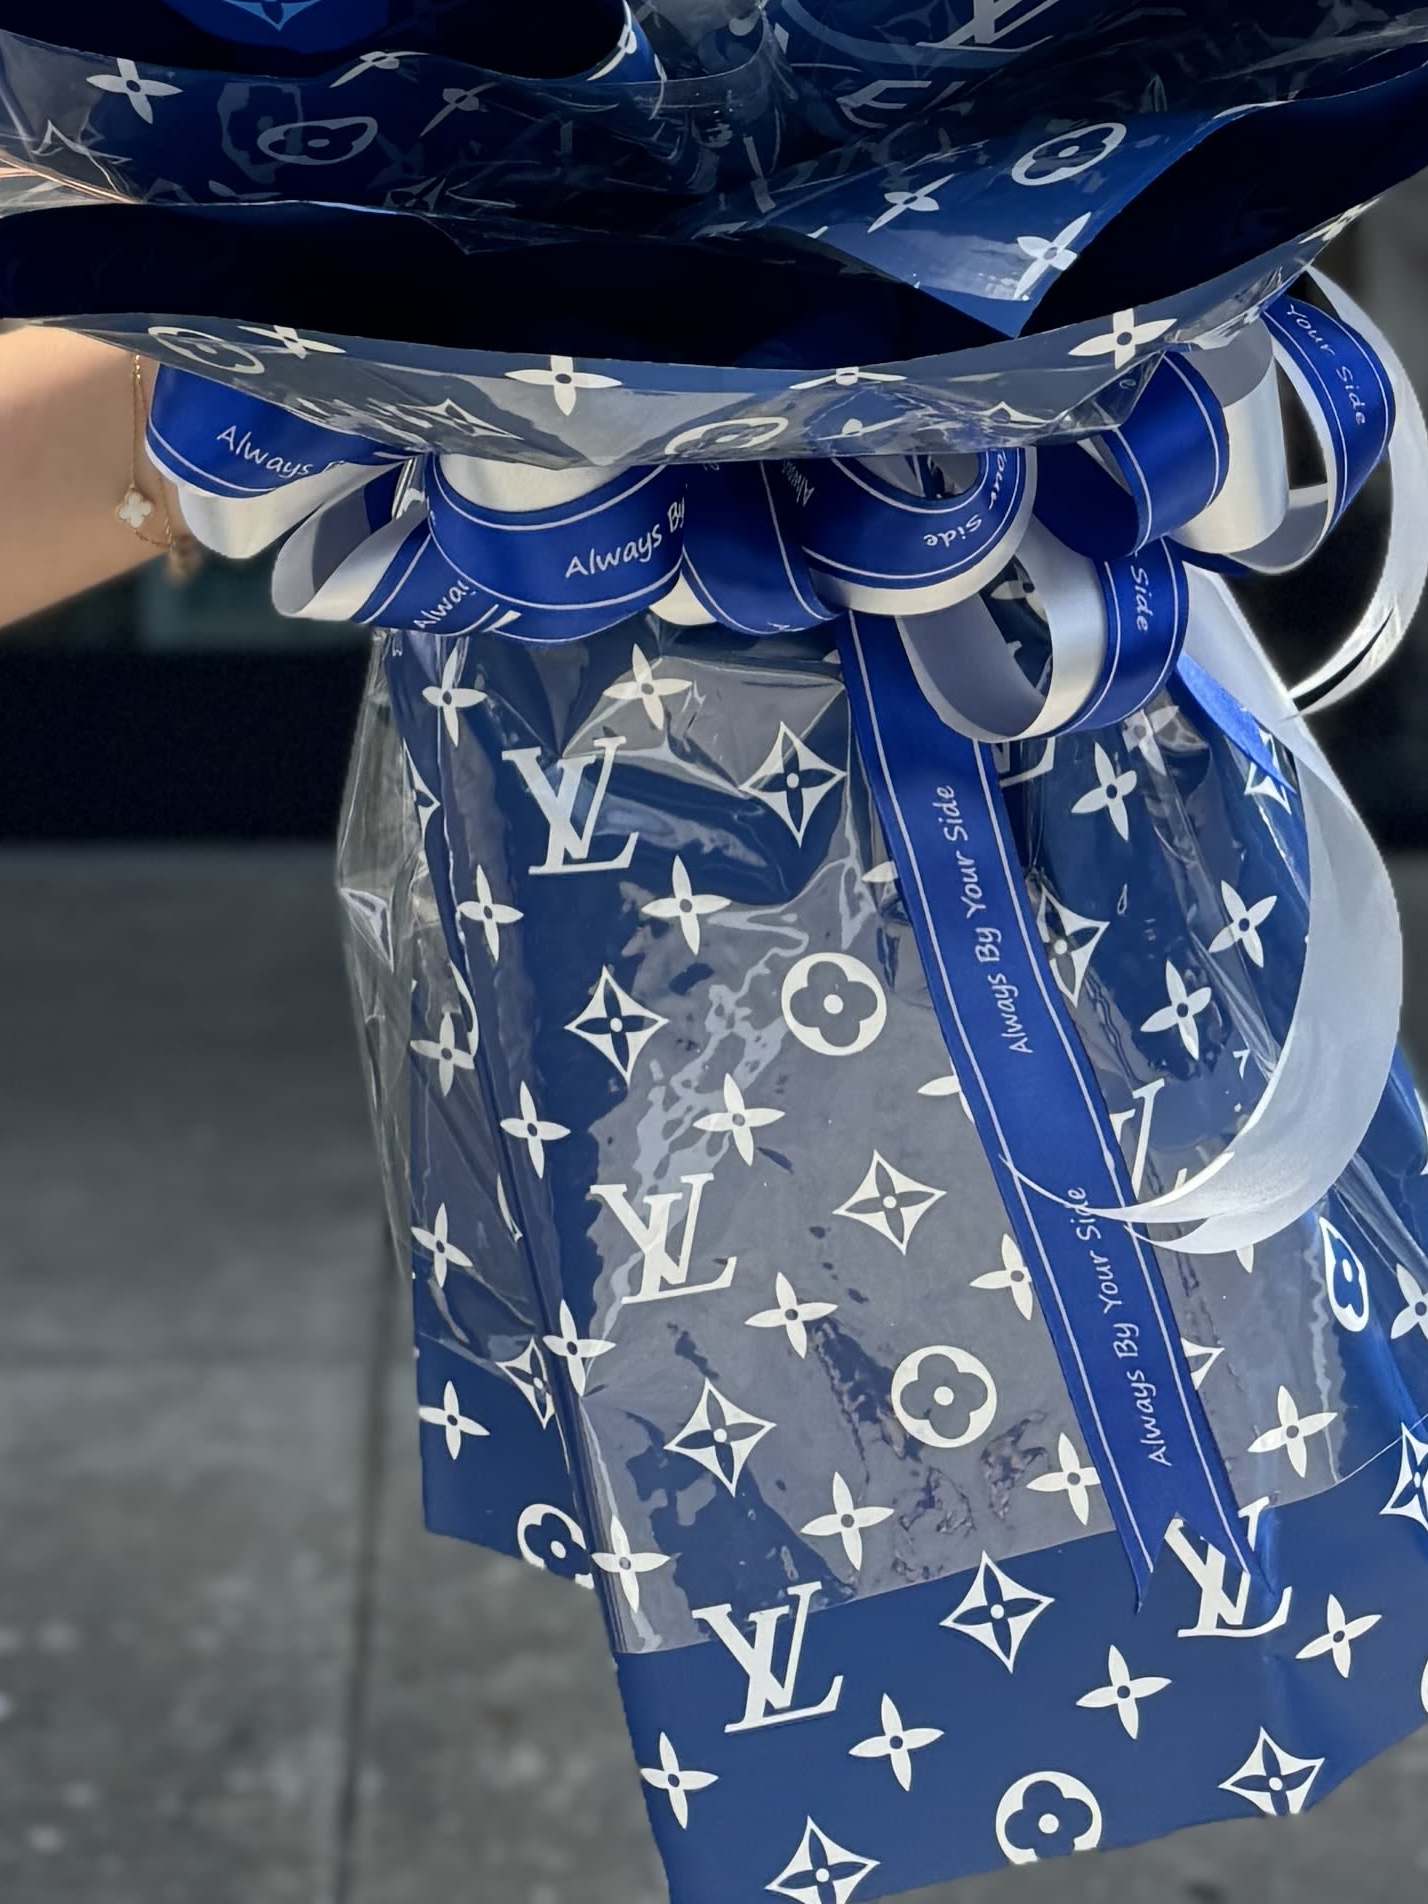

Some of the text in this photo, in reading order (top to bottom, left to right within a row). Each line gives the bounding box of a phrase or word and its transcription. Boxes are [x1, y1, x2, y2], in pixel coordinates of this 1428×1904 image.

[1287, 303, 1367, 426] Your Side
[216, 424, 314, 480] Always
[564, 523, 663, 579] Always
[923, 513, 983, 550] Side
[1129, 563, 1155, 632] Side
[932, 783, 1034, 1054] Always By Your Side
[1089, 1249, 1124, 1314] Your
[1112, 1322, 1140, 1359] By
[1126, 1369, 1172, 1467] Always
